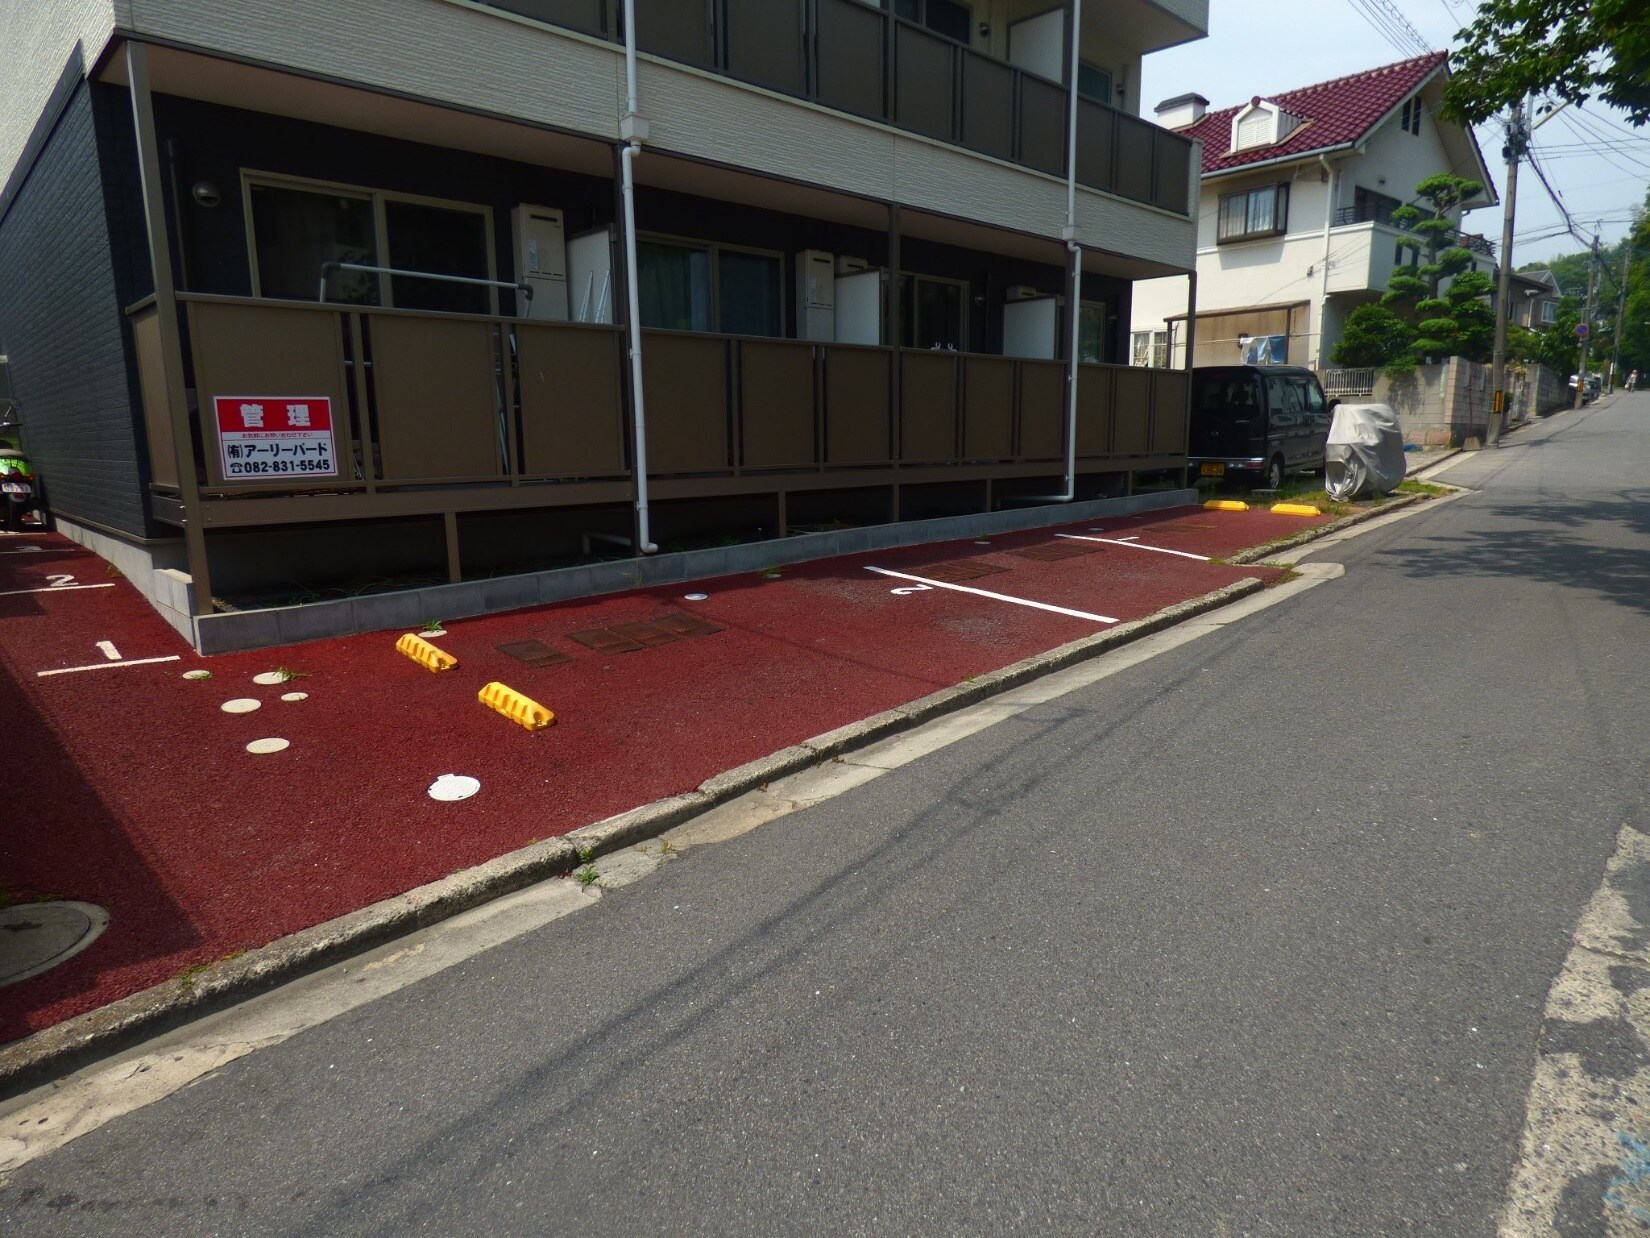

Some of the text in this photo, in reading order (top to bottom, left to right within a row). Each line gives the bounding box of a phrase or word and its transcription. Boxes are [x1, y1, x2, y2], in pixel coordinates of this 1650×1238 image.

[240, 403, 311, 427] 管理
[244, 459, 330, 473] 082-831-5545
[46, 574, 79, 587] 2
[890, 583, 933, 595] 2
[96, 640, 122, 660] 1
